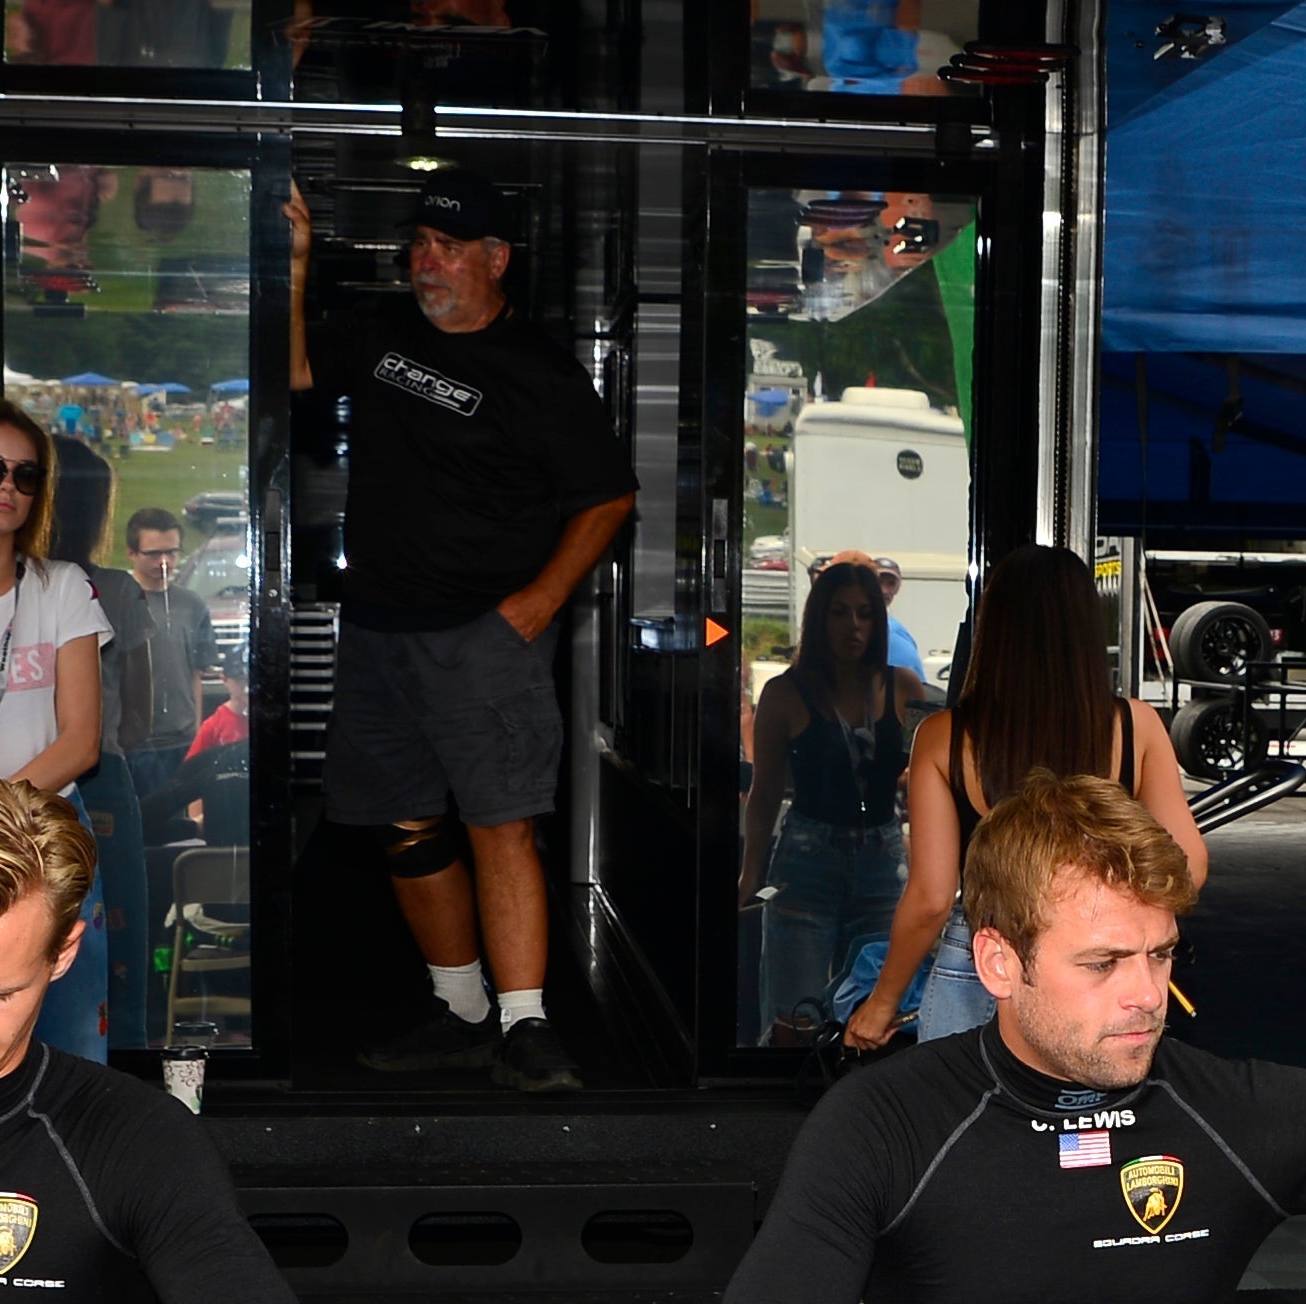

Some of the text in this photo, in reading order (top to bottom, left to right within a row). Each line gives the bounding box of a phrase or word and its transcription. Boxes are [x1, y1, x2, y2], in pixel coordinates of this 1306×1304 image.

[378, 368, 434, 398] RACING
[383, 355, 471, 403] change
[1063, 1109, 1136, 1131] LEWIS
[1128, 1166, 1175, 1179] AUTOMOBILI
[1126, 1176, 1179, 1192] LAMBORGHINI
[1093, 1229, 1210, 1249] SQUADRA CORSE
[12, 1278, 66, 1288] CORSE
